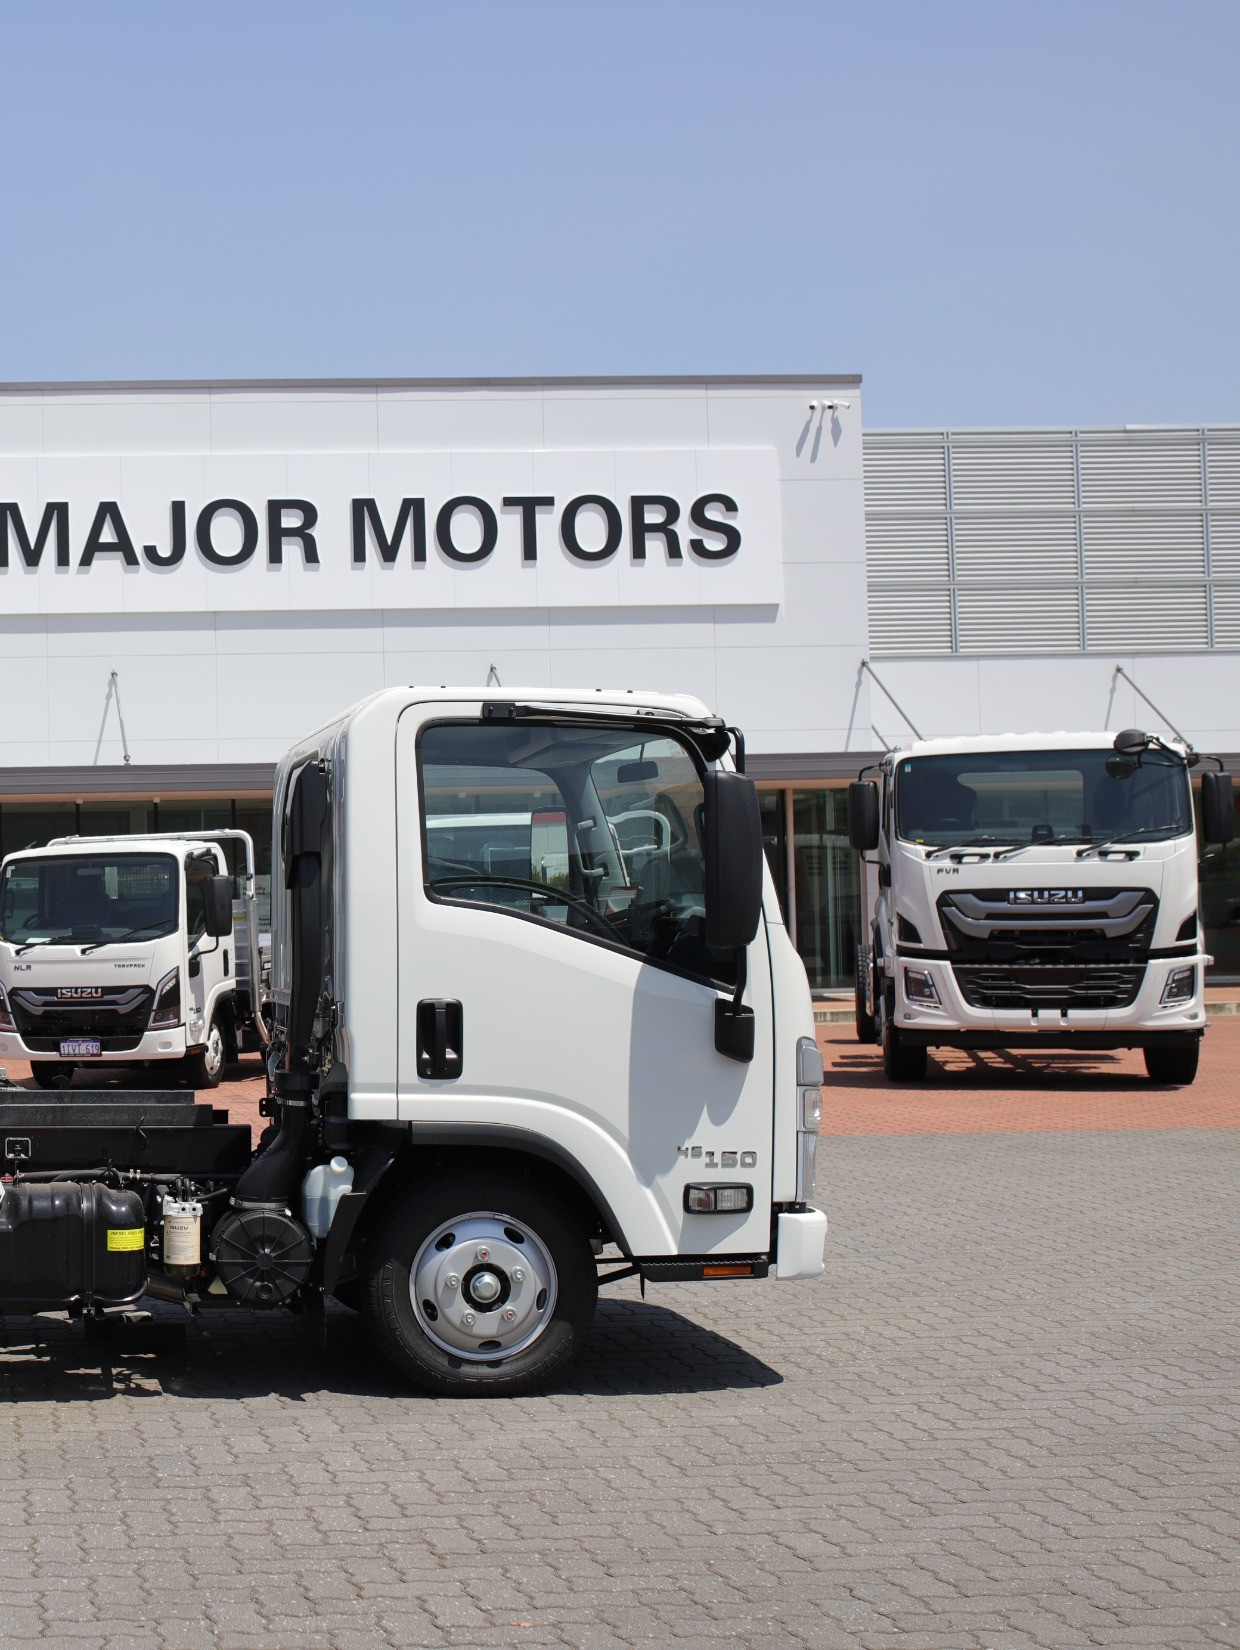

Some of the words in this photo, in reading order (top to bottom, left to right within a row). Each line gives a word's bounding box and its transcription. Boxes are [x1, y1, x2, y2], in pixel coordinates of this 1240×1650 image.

[351, 493, 742, 563] MOTORS
[1009, 890, 1083, 904] ISUZU
[57, 987, 102, 998] ISUZU
[85, 1044, 100, 1054] 619
[704, 1150, 758, 1169] 150
